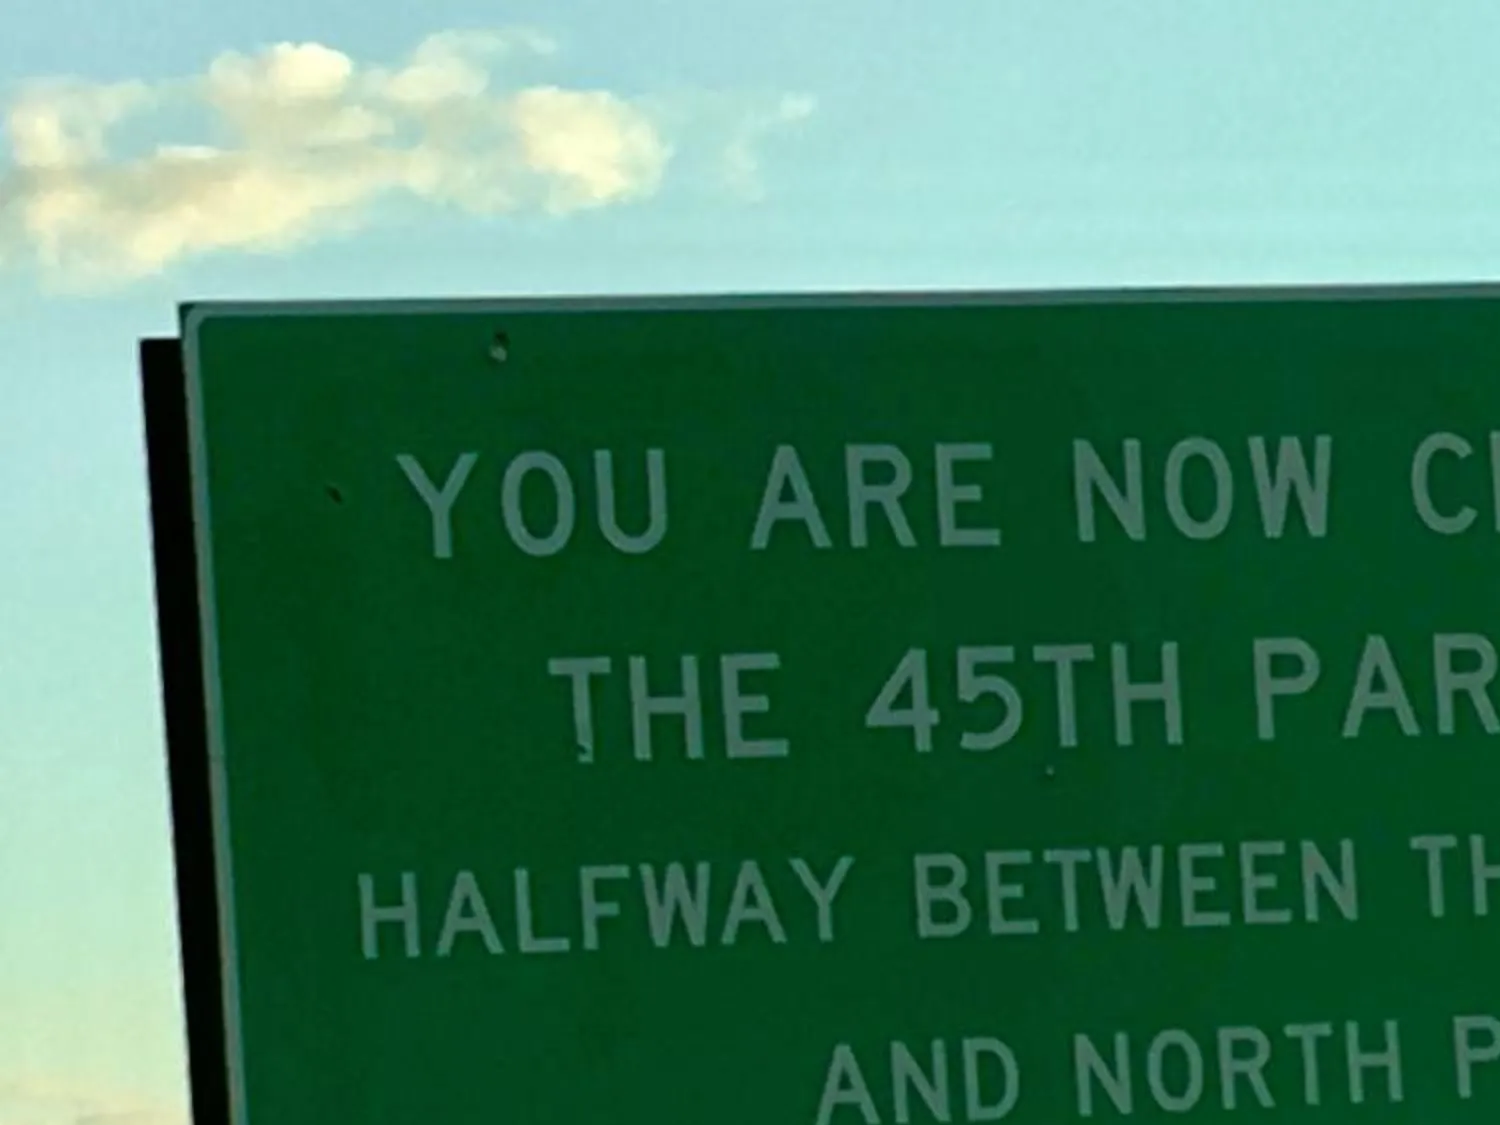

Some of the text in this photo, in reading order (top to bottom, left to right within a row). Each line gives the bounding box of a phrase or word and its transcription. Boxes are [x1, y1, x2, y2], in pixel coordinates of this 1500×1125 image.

[397, 449, 667, 558] YOU
[751, 443, 1000, 548] ARE
[1073, 435, 1331, 542] NOW
[548, 653, 788, 762] THE
[866, 642, 1182, 752] 45TH
[359, 857, 852, 959] HALFWAY
[914, 838, 1357, 937] BETWEEN
[1075, 1020, 1403, 1116] NORTH
